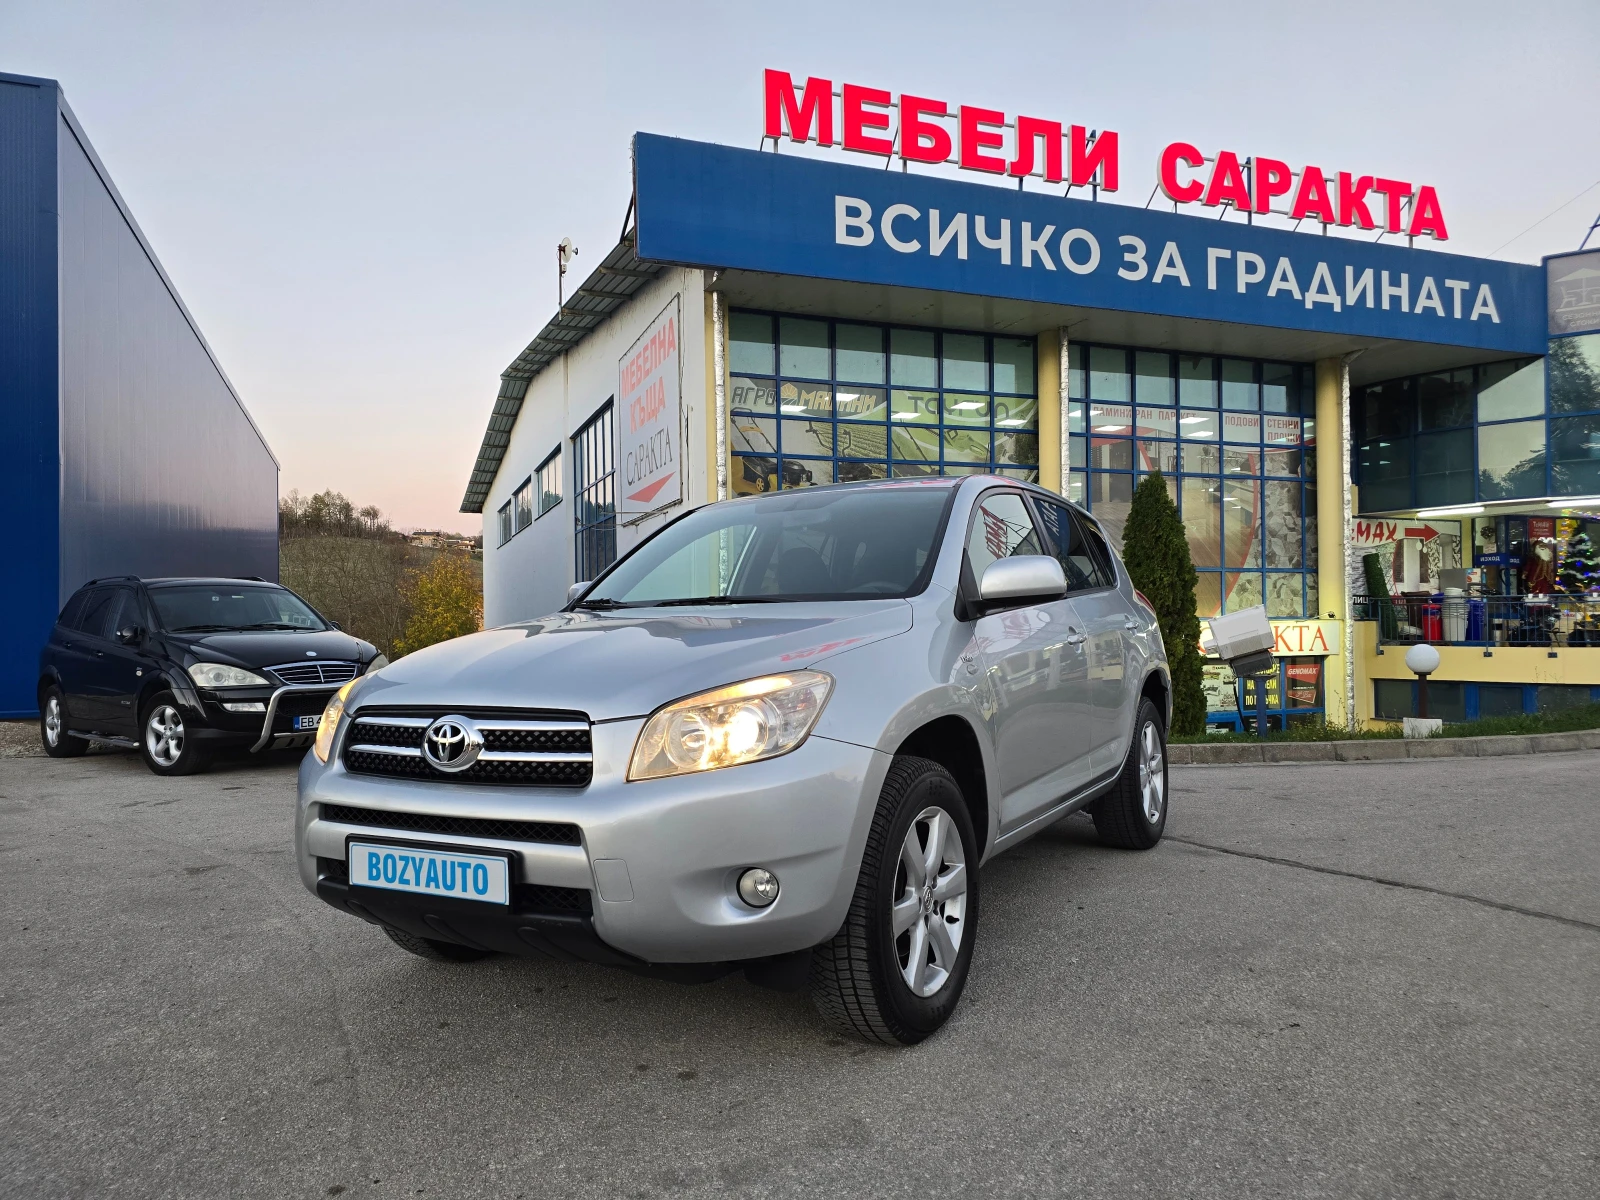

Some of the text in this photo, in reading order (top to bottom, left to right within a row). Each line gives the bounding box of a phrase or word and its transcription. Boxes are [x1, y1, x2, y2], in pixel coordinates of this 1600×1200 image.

[762, 68, 1449, 241] МЕБЕЛИ САРАКТА
[834, 195, 1501, 324] ВСИЧКО ЗА ГРАДИНАТА
[620, 316, 677, 400] МЕБЕЛНА
[629, 376, 667, 434] КЪЩА
[731, 386, 776, 406] АГРО
[1225, 416, 1259, 428] ПОДОВИ
[1267, 418, 1299, 429] СТЕННИ
[626, 425, 673, 487] САРАКТА
[367, 851, 489, 896] BOZYAUTO
